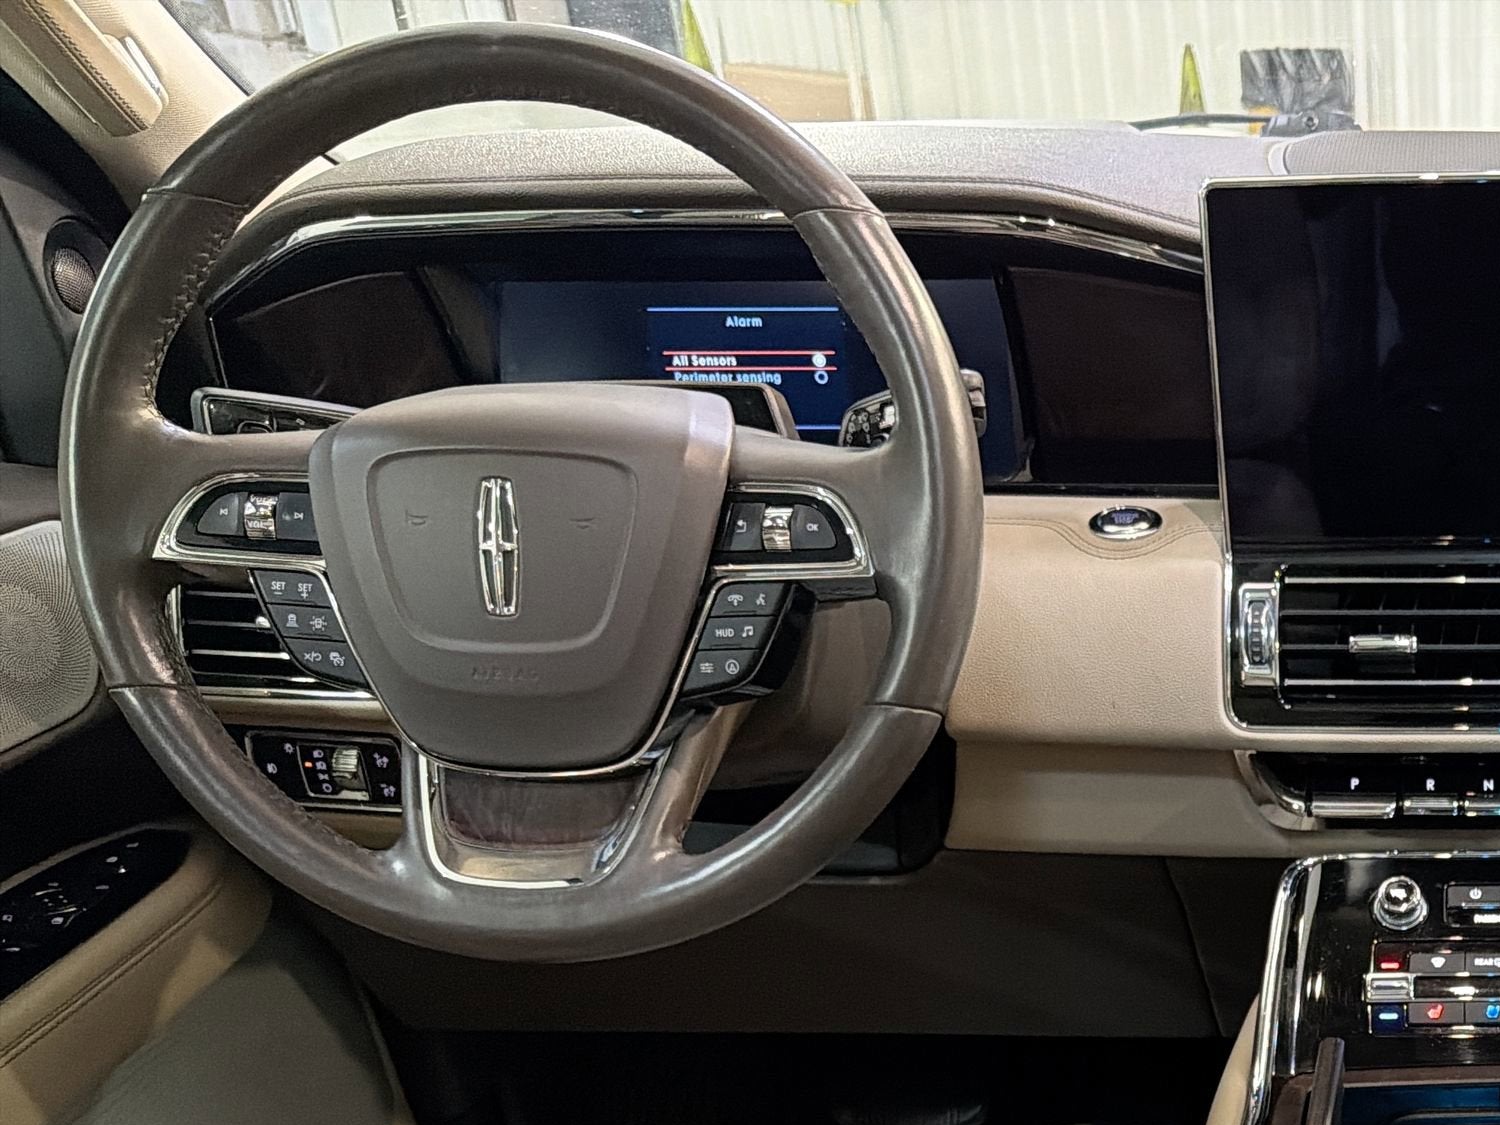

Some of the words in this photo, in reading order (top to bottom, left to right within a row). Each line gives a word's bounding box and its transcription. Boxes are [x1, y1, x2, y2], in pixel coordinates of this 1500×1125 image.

[725, 315, 763, 328] Alarm
[672, 355, 689, 367] All
[691, 354, 737, 367] Sensors
[674, 371, 733, 383] Perimeter
[736, 371, 782, 385] sensing
[806, 523, 819, 532] OK
[271, 580, 286, 591] SET
[297, 582, 313, 593] SET
[715, 628, 735, 638] HUD
[1350, 777, 1360, 791] P
[1426, 778, 1436, 791] R
[1483, 779, 1495, 792] N
[1474, 957, 1494, 966] REAR
